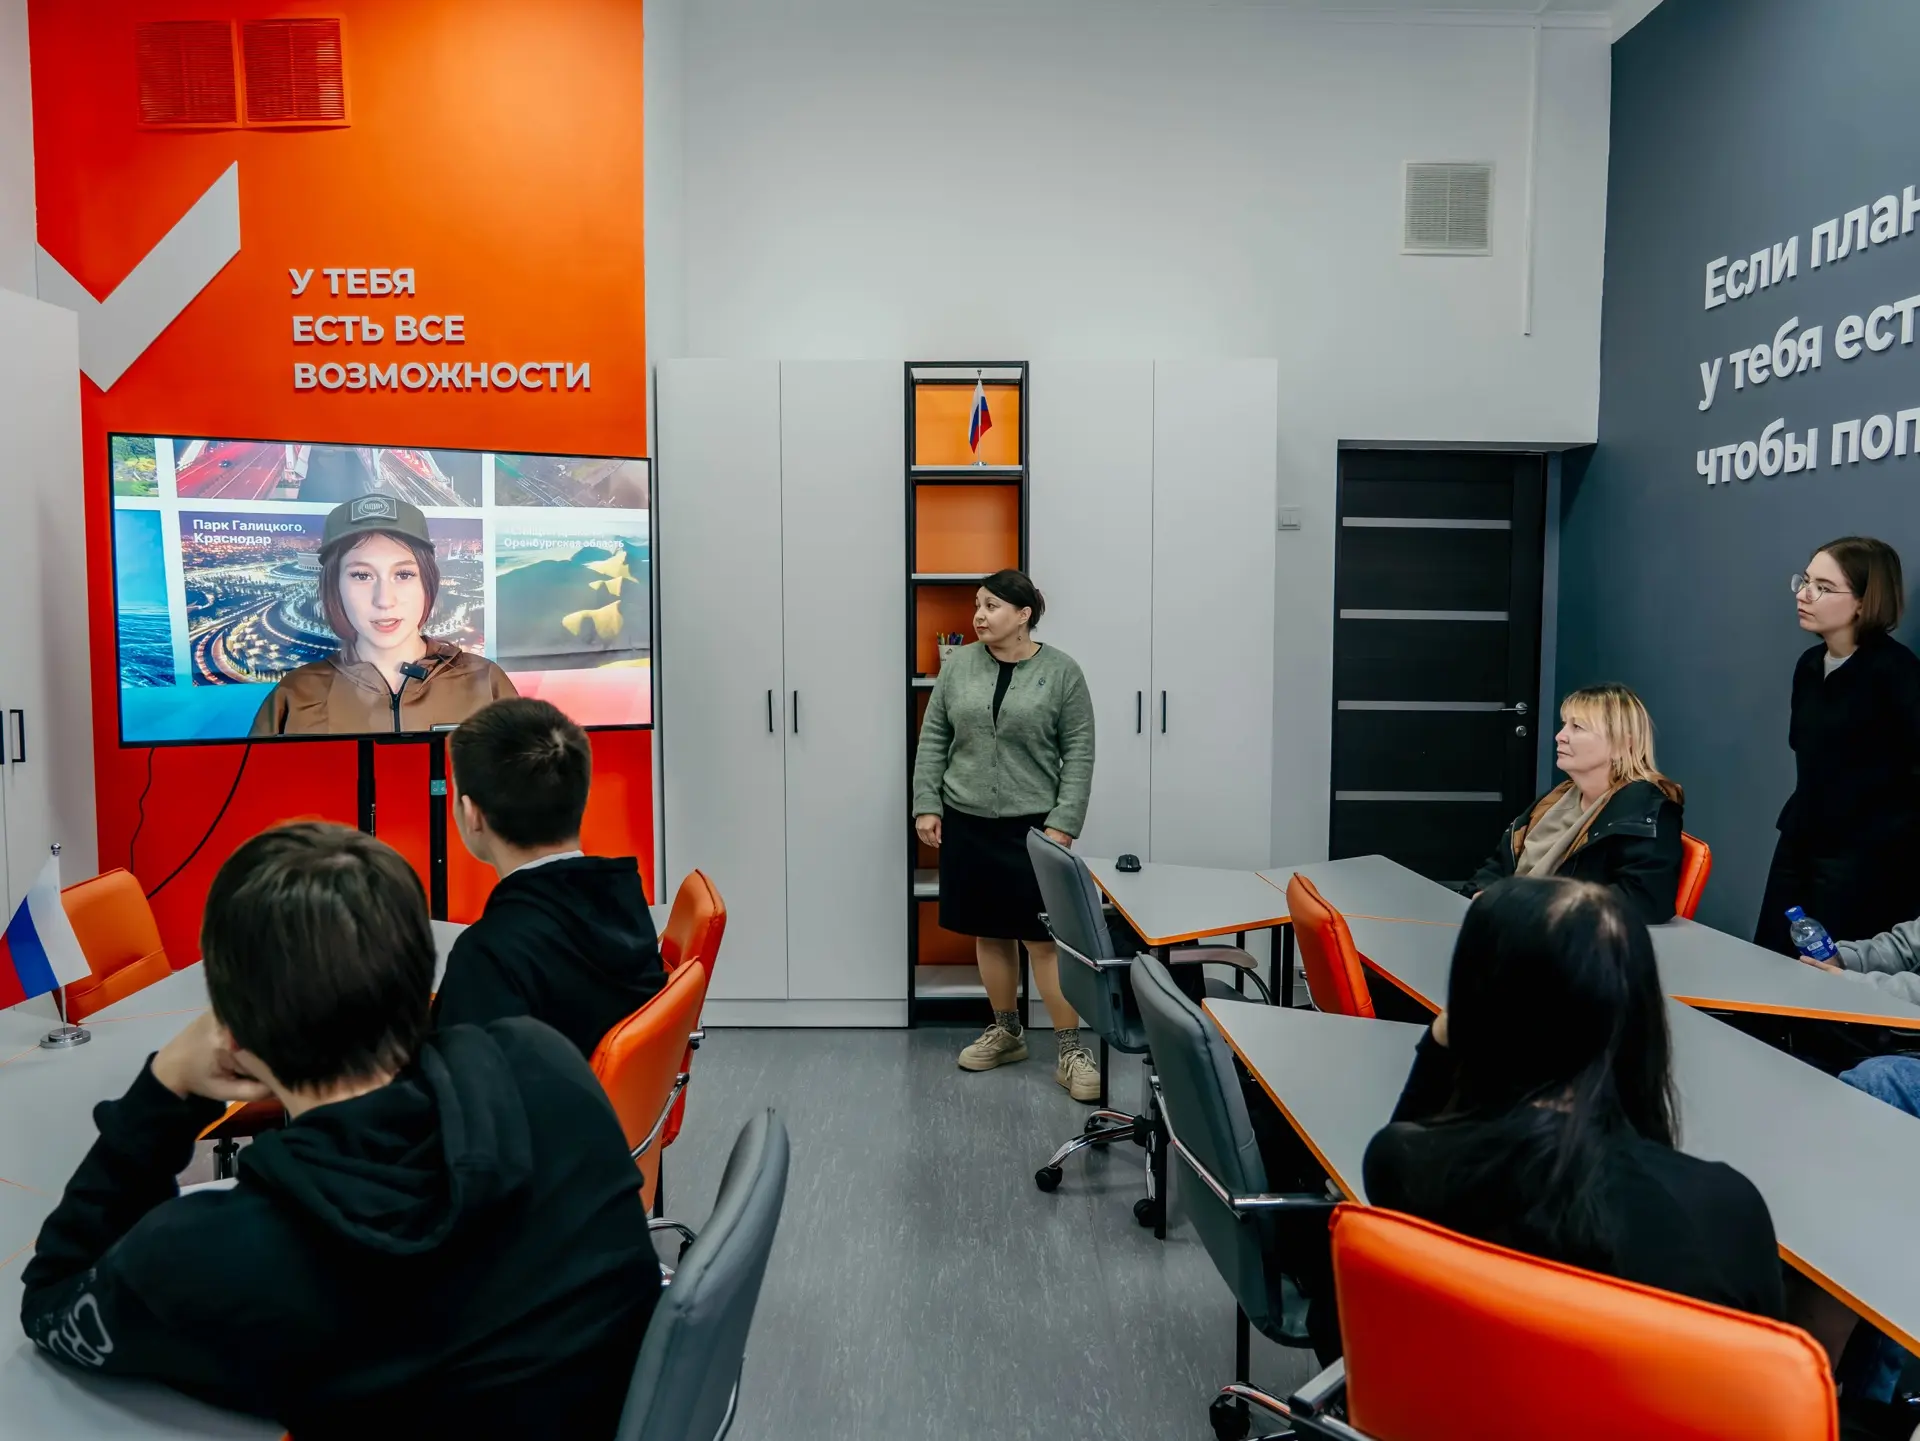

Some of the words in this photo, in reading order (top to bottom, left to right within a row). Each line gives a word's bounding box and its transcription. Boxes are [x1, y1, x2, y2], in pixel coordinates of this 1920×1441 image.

[288, 268, 315, 296] У
[322, 267, 416, 295] ТЕБЯ
[1704, 236, 1799, 311] Если
[292, 315, 385, 342] ЕСТЬ
[395, 315, 466, 342] ВСЕ
[1698, 357, 1722, 411] у
[1729, 316, 1824, 390] тебя
[1834, 294, 1920, 361] ест
[294, 362, 591, 389] ВОЗМОЖНОСТИ
[1696, 417, 1819, 486] чтобы
[193, 519, 230, 533] Парк
[232, 520, 306, 534] Галицкого,
[193, 533, 272, 547] Краснодар
[504, 538, 581, 550] Оренбургская
[583, 539, 625, 549] область
